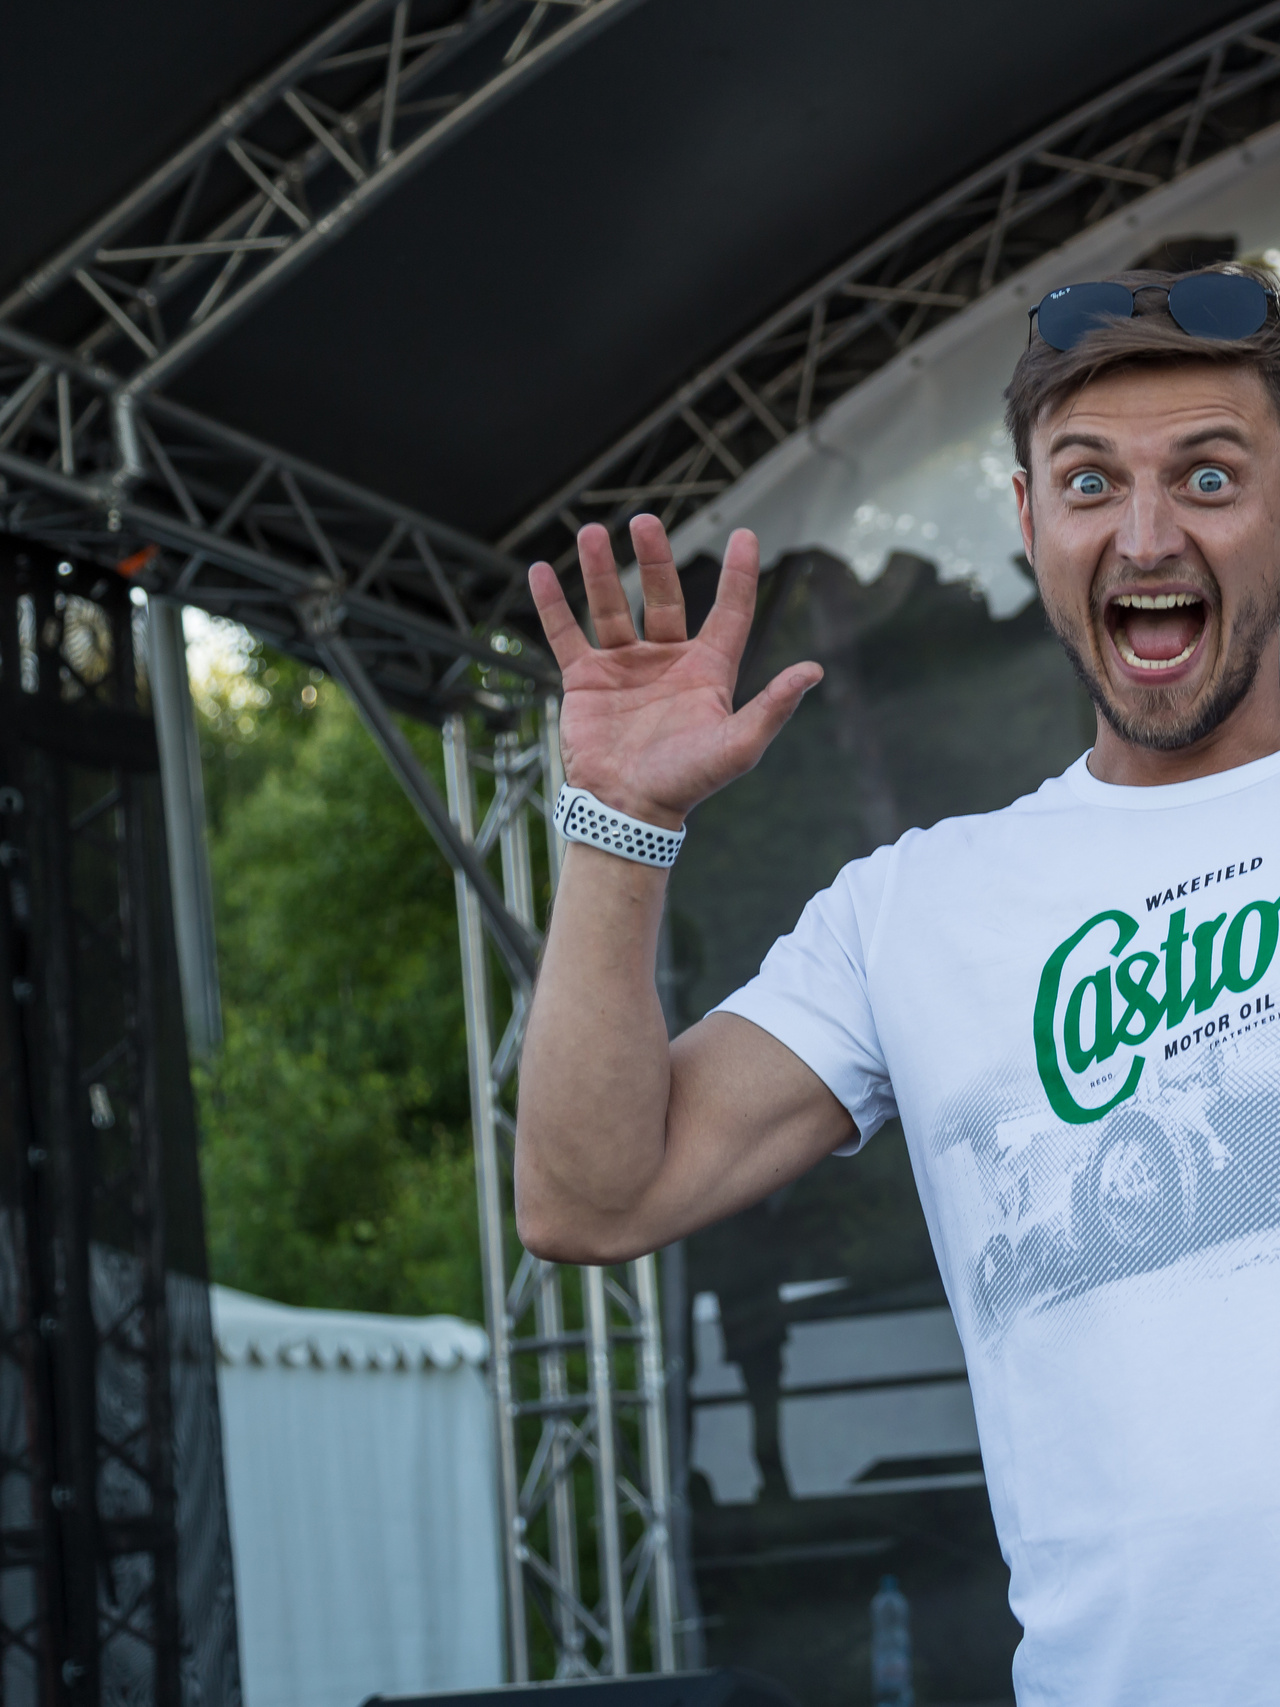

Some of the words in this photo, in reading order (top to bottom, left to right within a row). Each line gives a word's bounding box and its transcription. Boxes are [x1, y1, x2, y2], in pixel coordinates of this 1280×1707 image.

[1144, 856, 1264, 912] WAKEFIELD
[1164, 1013, 1230, 1061] MOTOR
[1239, 993, 1276, 1021] OIL
